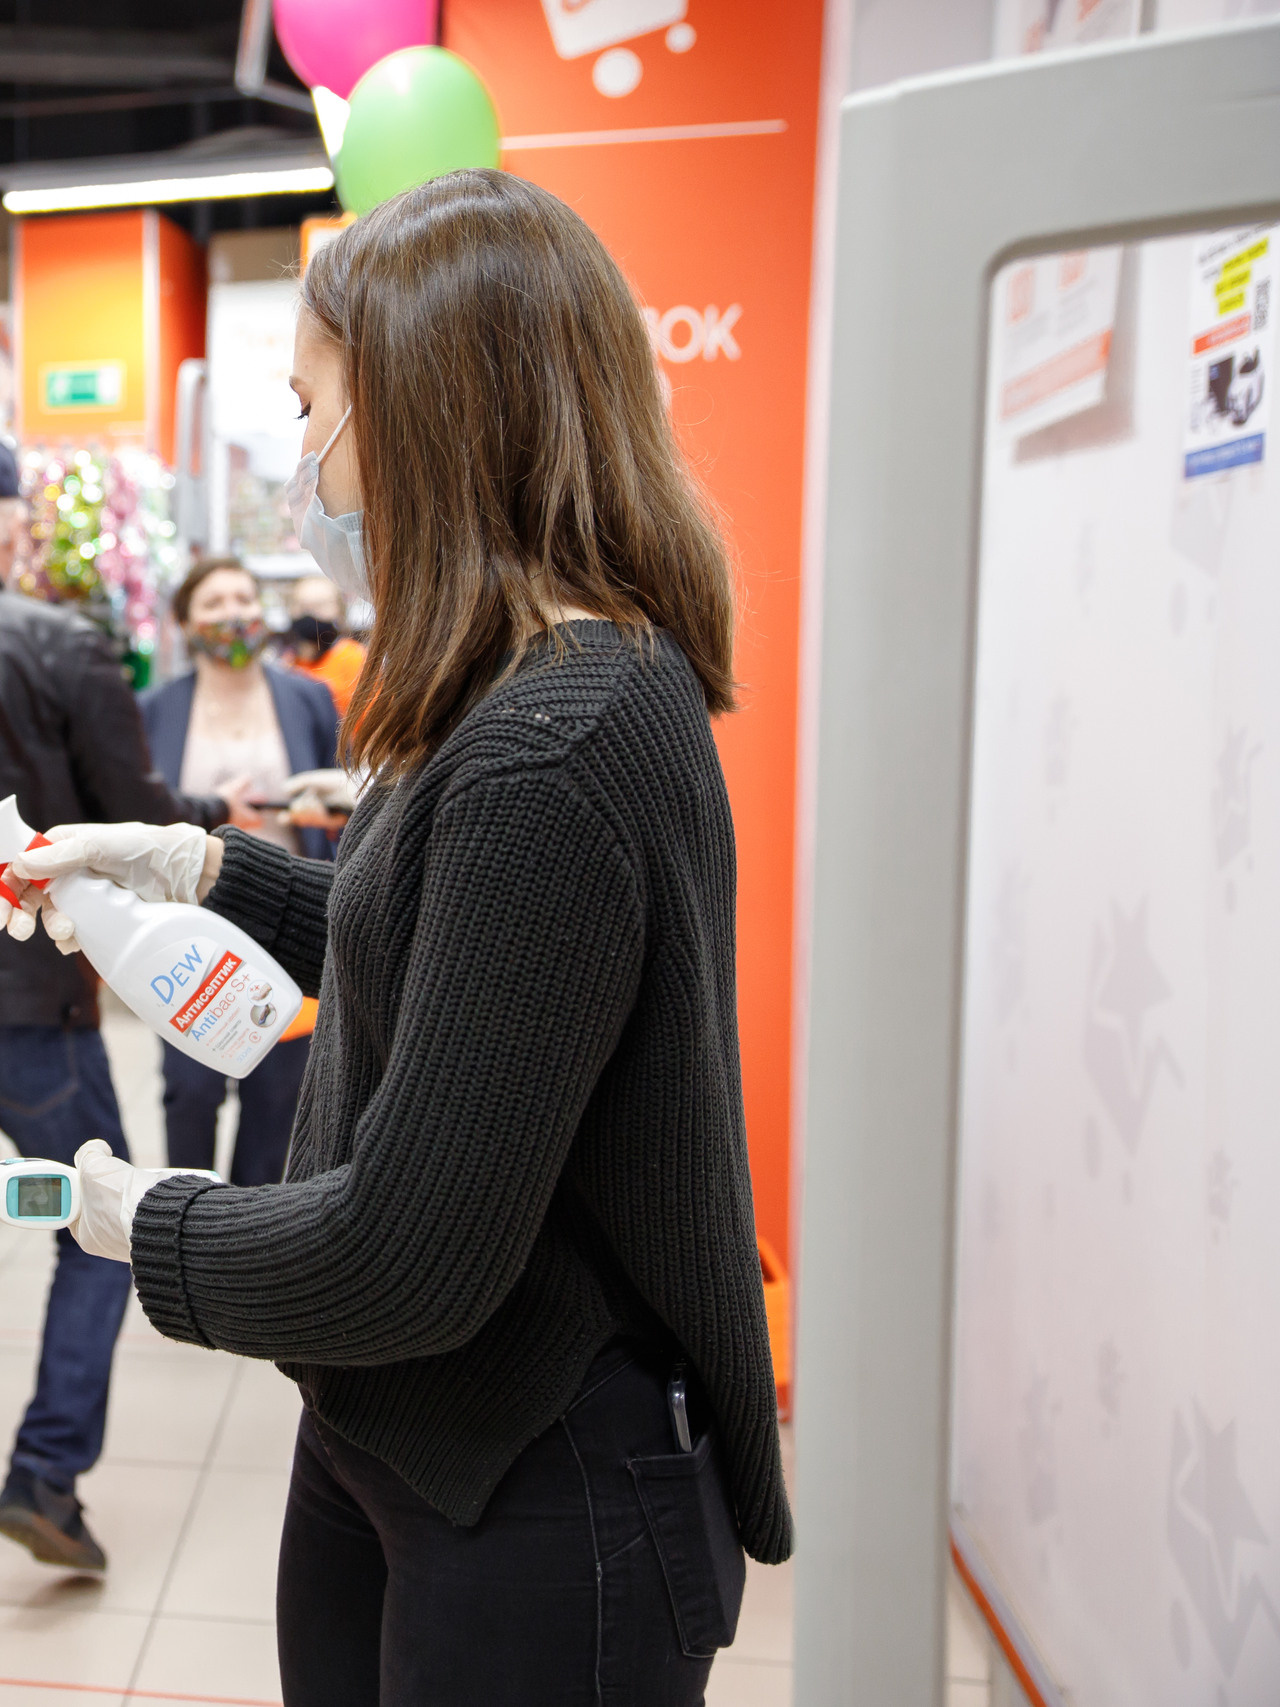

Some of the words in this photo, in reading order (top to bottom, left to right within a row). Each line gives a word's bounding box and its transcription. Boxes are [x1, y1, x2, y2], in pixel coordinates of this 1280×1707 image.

[150, 944, 203, 1005] DEW
[175, 957, 238, 1029] Антисептик
[191, 991, 236, 1041] Antibac
